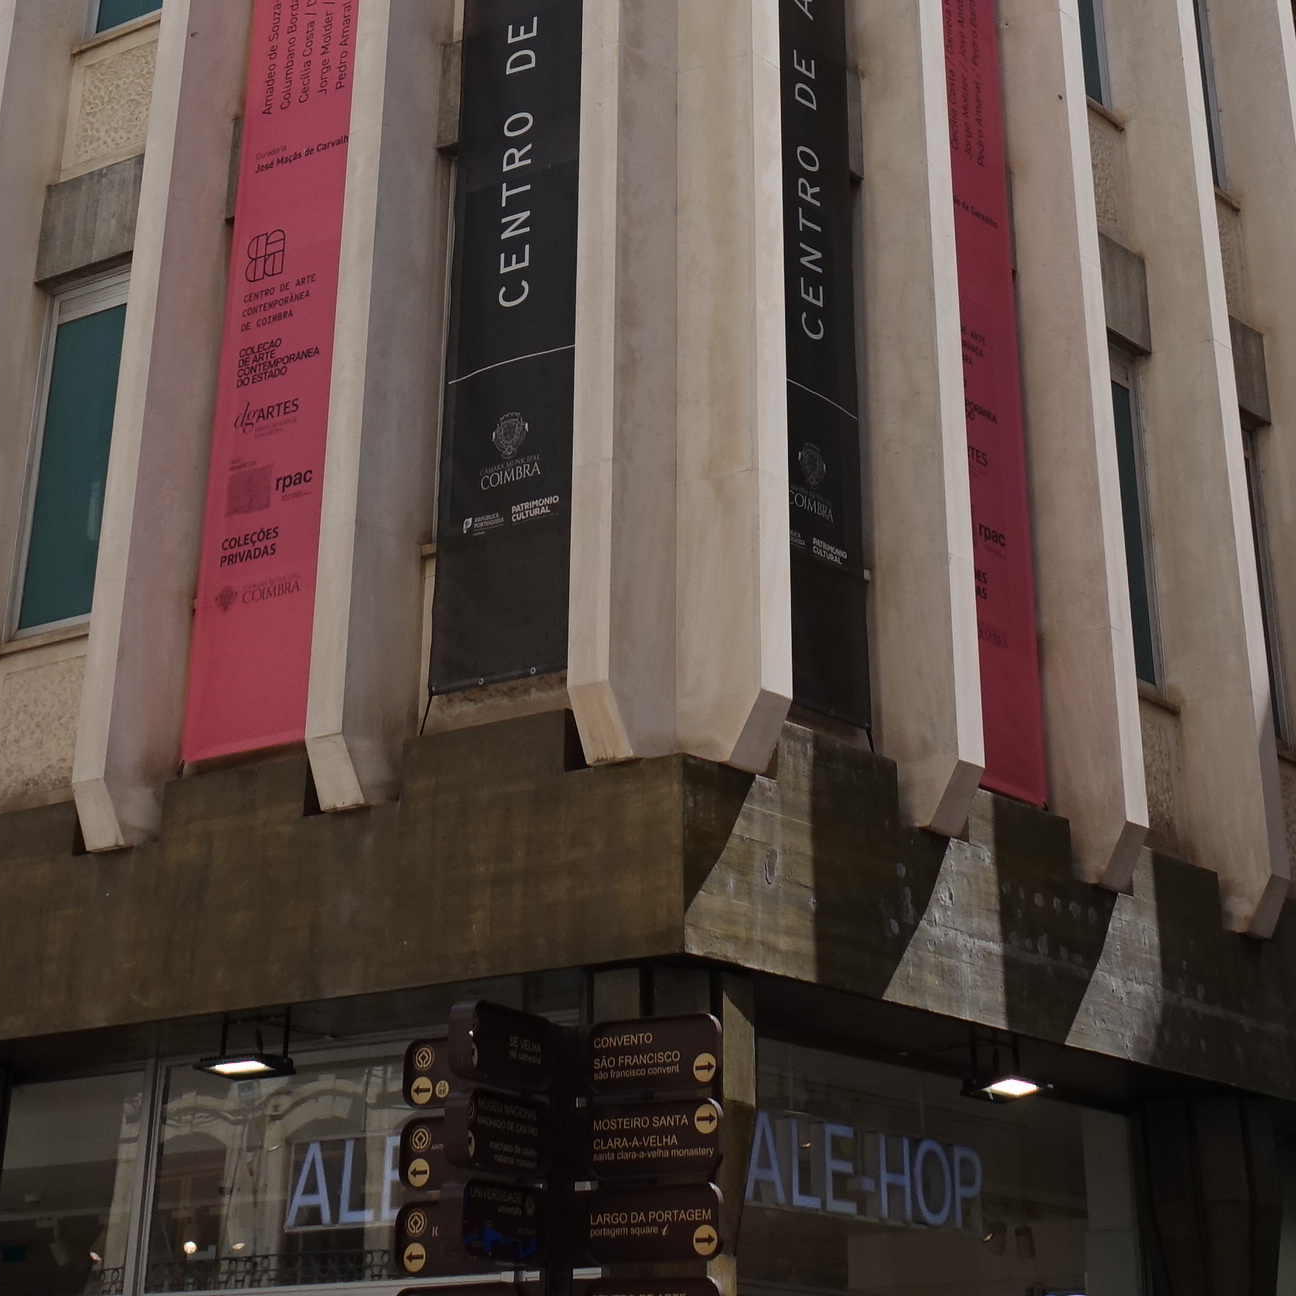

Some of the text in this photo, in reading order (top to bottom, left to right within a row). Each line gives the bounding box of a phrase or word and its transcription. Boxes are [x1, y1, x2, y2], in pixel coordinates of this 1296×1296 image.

[321, 10, 333, 54] Molder
[338, 0, 352, 46] Amaral
[302, 20, 315, 58] Costa
[506, 15, 538, 75] DE
[266, 44, 278, 60] de
[280, 36, 296, 110] Columbano
[298, 58, 311, 104] Cecília
[317, 58, 331, 95] Jorge
[334, 50, 348, 90] Pedro
[794, 49, 817, 111] DE
[261, 62, 276, 116] Amadeo
[255, 134, 349, 174] José Maçãs de Carvalh
[256, 144, 287, 160] Curadoria
[499, 112, 533, 308] CENTRO
[797, 145, 825, 340] CENTRO
[243, 273, 316, 303] CENTRO DE ARTE
[242, 290, 310, 318] CONTEMPORÂNEA
[241, 310, 293, 332] DE COIMBRA
[238, 350, 275, 368] DE ARTE
[236, 367, 288, 388] DO ESTADO
[275, 469, 313, 492] rpac
[480, 462, 541, 490] COIMBRA
[511, 506, 551, 522] CULTURAL
[789, 489, 834, 522] COIMBRA
[222, 526, 279, 552] COLEÇÕES
[978, 523, 1006, 547] rpac
[220, 543, 276, 567] PRIVADAS
[242, 580, 300, 604] COIMBRA
[519, 1039, 542, 1053] VELHA
[594, 1032, 653, 1049] CONVENTO
[594, 1050, 680, 1070] SÃO FRANCISCO
[610, 1067, 646, 1079] francisco
[647, 1064, 680, 1075] convent
[593, 1114, 688, 1131] MOSTEIRO SANTA
[593, 1134, 678, 1150] CLARA-A-VELHA
[593, 1146, 714, 1161] santa clara-a-velha monastery
[746, 1111, 983, 1231] ALE-HOP
[470, 1186, 523, 1204] UNIVERSIDADE
[590, 1208, 712, 1226] LARGO DA PORTAGEM
[589, 1225, 659, 1239] portagem square
